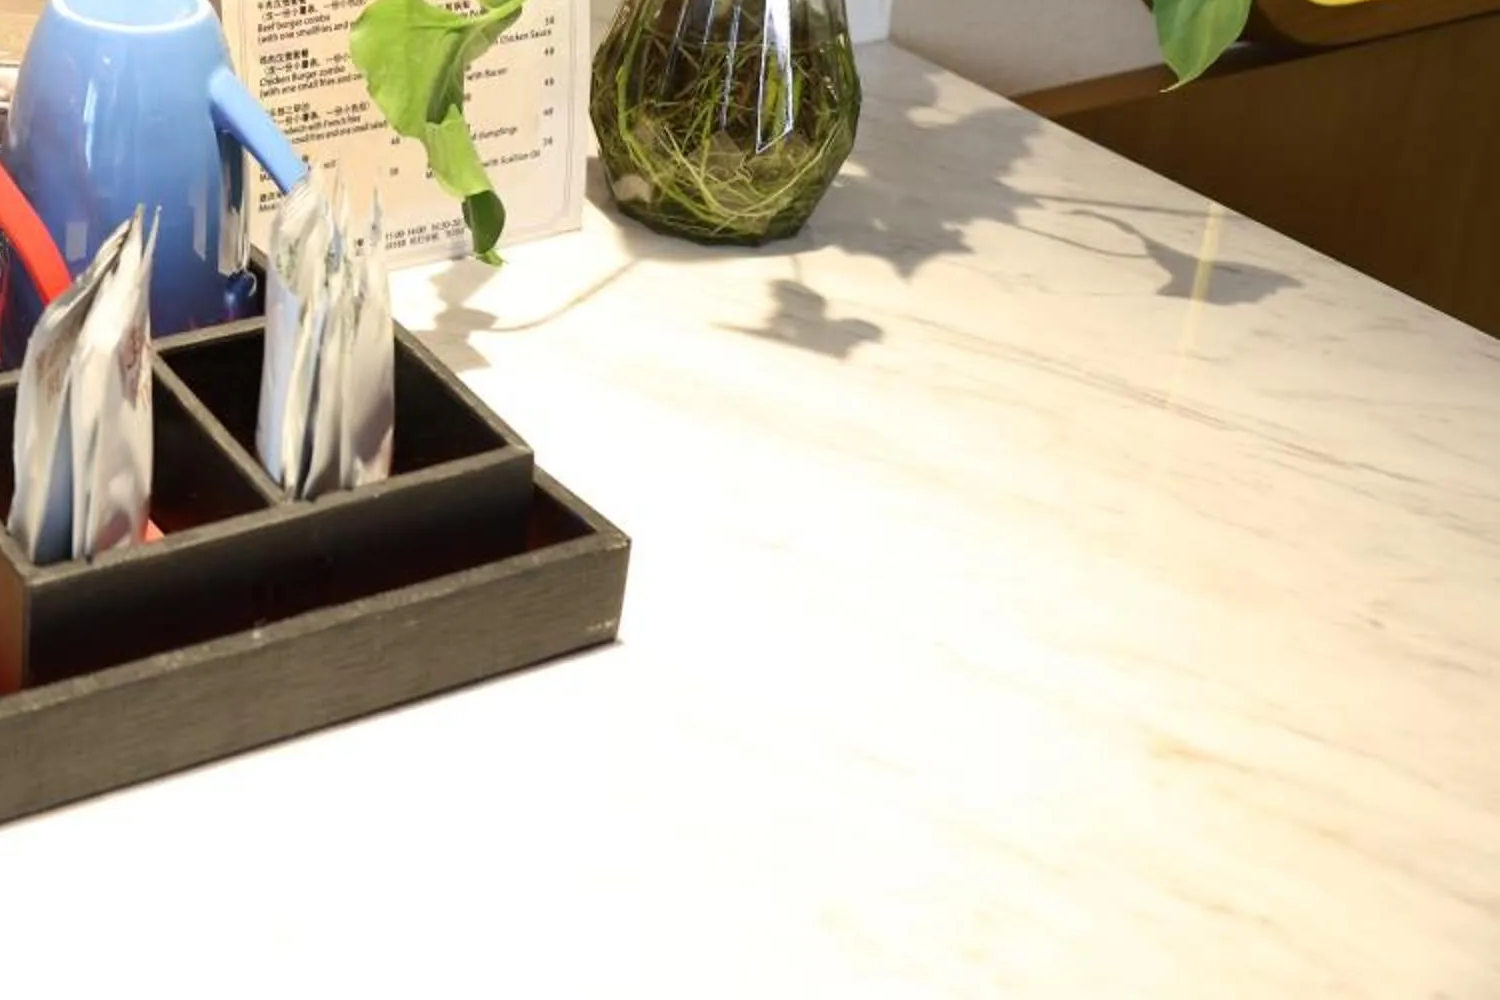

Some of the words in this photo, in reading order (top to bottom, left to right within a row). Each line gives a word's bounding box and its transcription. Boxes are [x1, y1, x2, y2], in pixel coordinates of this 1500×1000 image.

[257, 22, 275, 34] Beef
[275, 18, 303, 31] burger
[259, 74, 291, 87] Chicken
